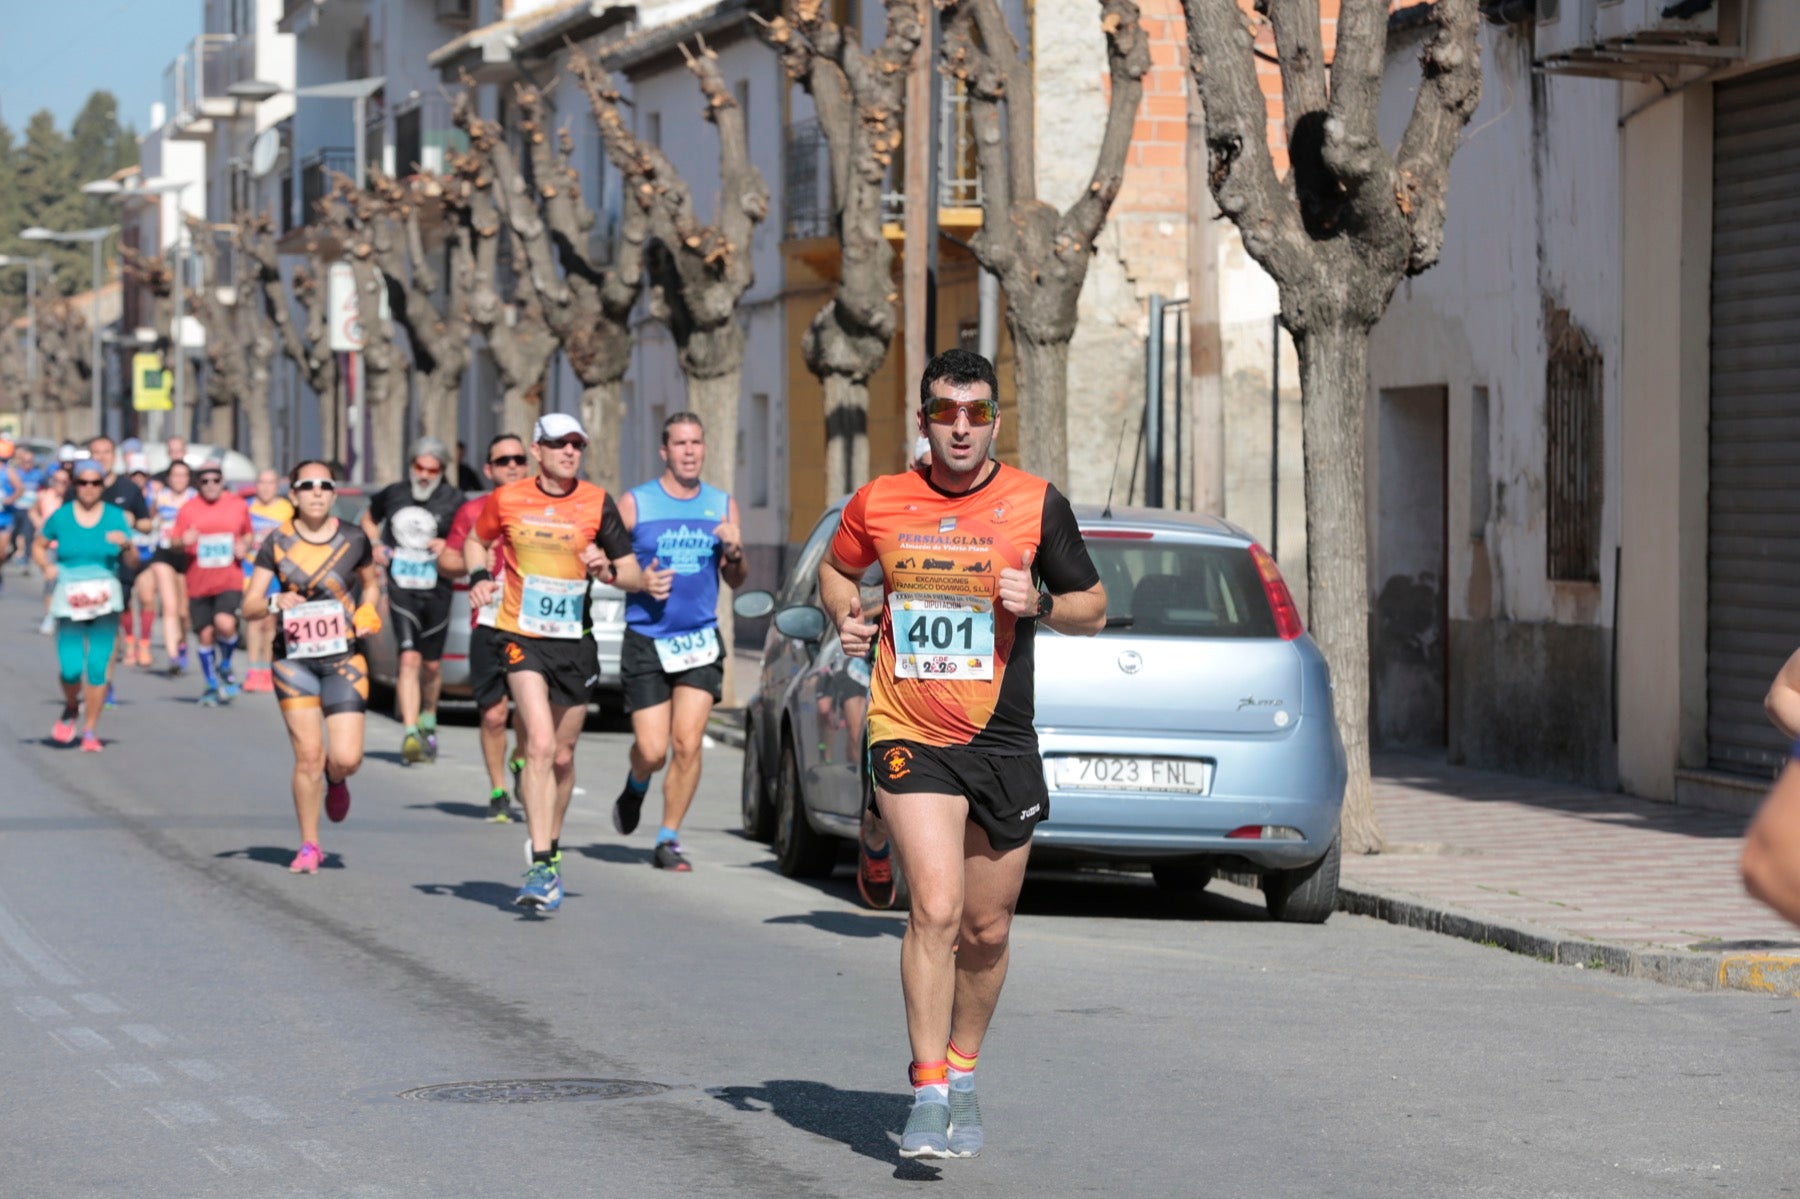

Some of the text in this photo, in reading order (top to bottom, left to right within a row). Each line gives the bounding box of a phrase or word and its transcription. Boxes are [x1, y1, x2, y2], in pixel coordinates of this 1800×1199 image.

[896, 581, 934, 590] FRANCISCO
[915, 576, 969, 584] EXCAVACIONES
[540, 596, 566, 618] 94
[289, 617, 339, 640] 2101
[908, 615, 973, 650] 401
[1079, 759, 1195, 785] 7023 FNL
